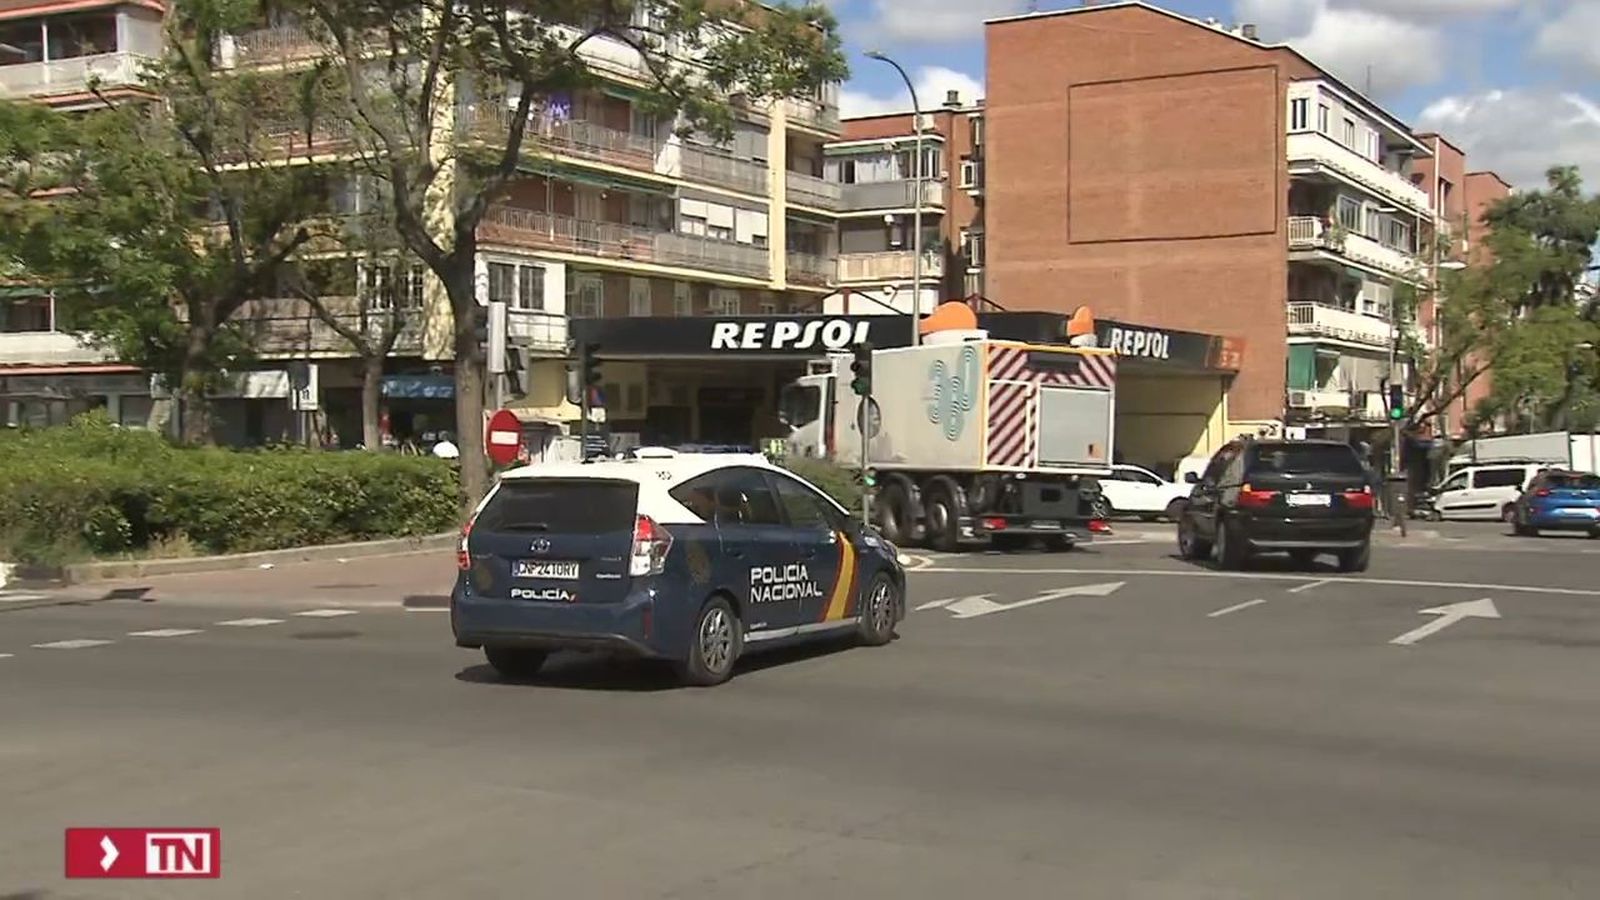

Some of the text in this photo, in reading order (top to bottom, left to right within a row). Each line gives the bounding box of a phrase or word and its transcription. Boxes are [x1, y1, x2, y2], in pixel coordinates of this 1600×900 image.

[1110, 327, 1170, 360] REPSOL
[750, 561, 809, 586] POLICÍA
[510, 588, 571, 600] POLICÍA
[750, 581, 823, 604] NACIONAL
